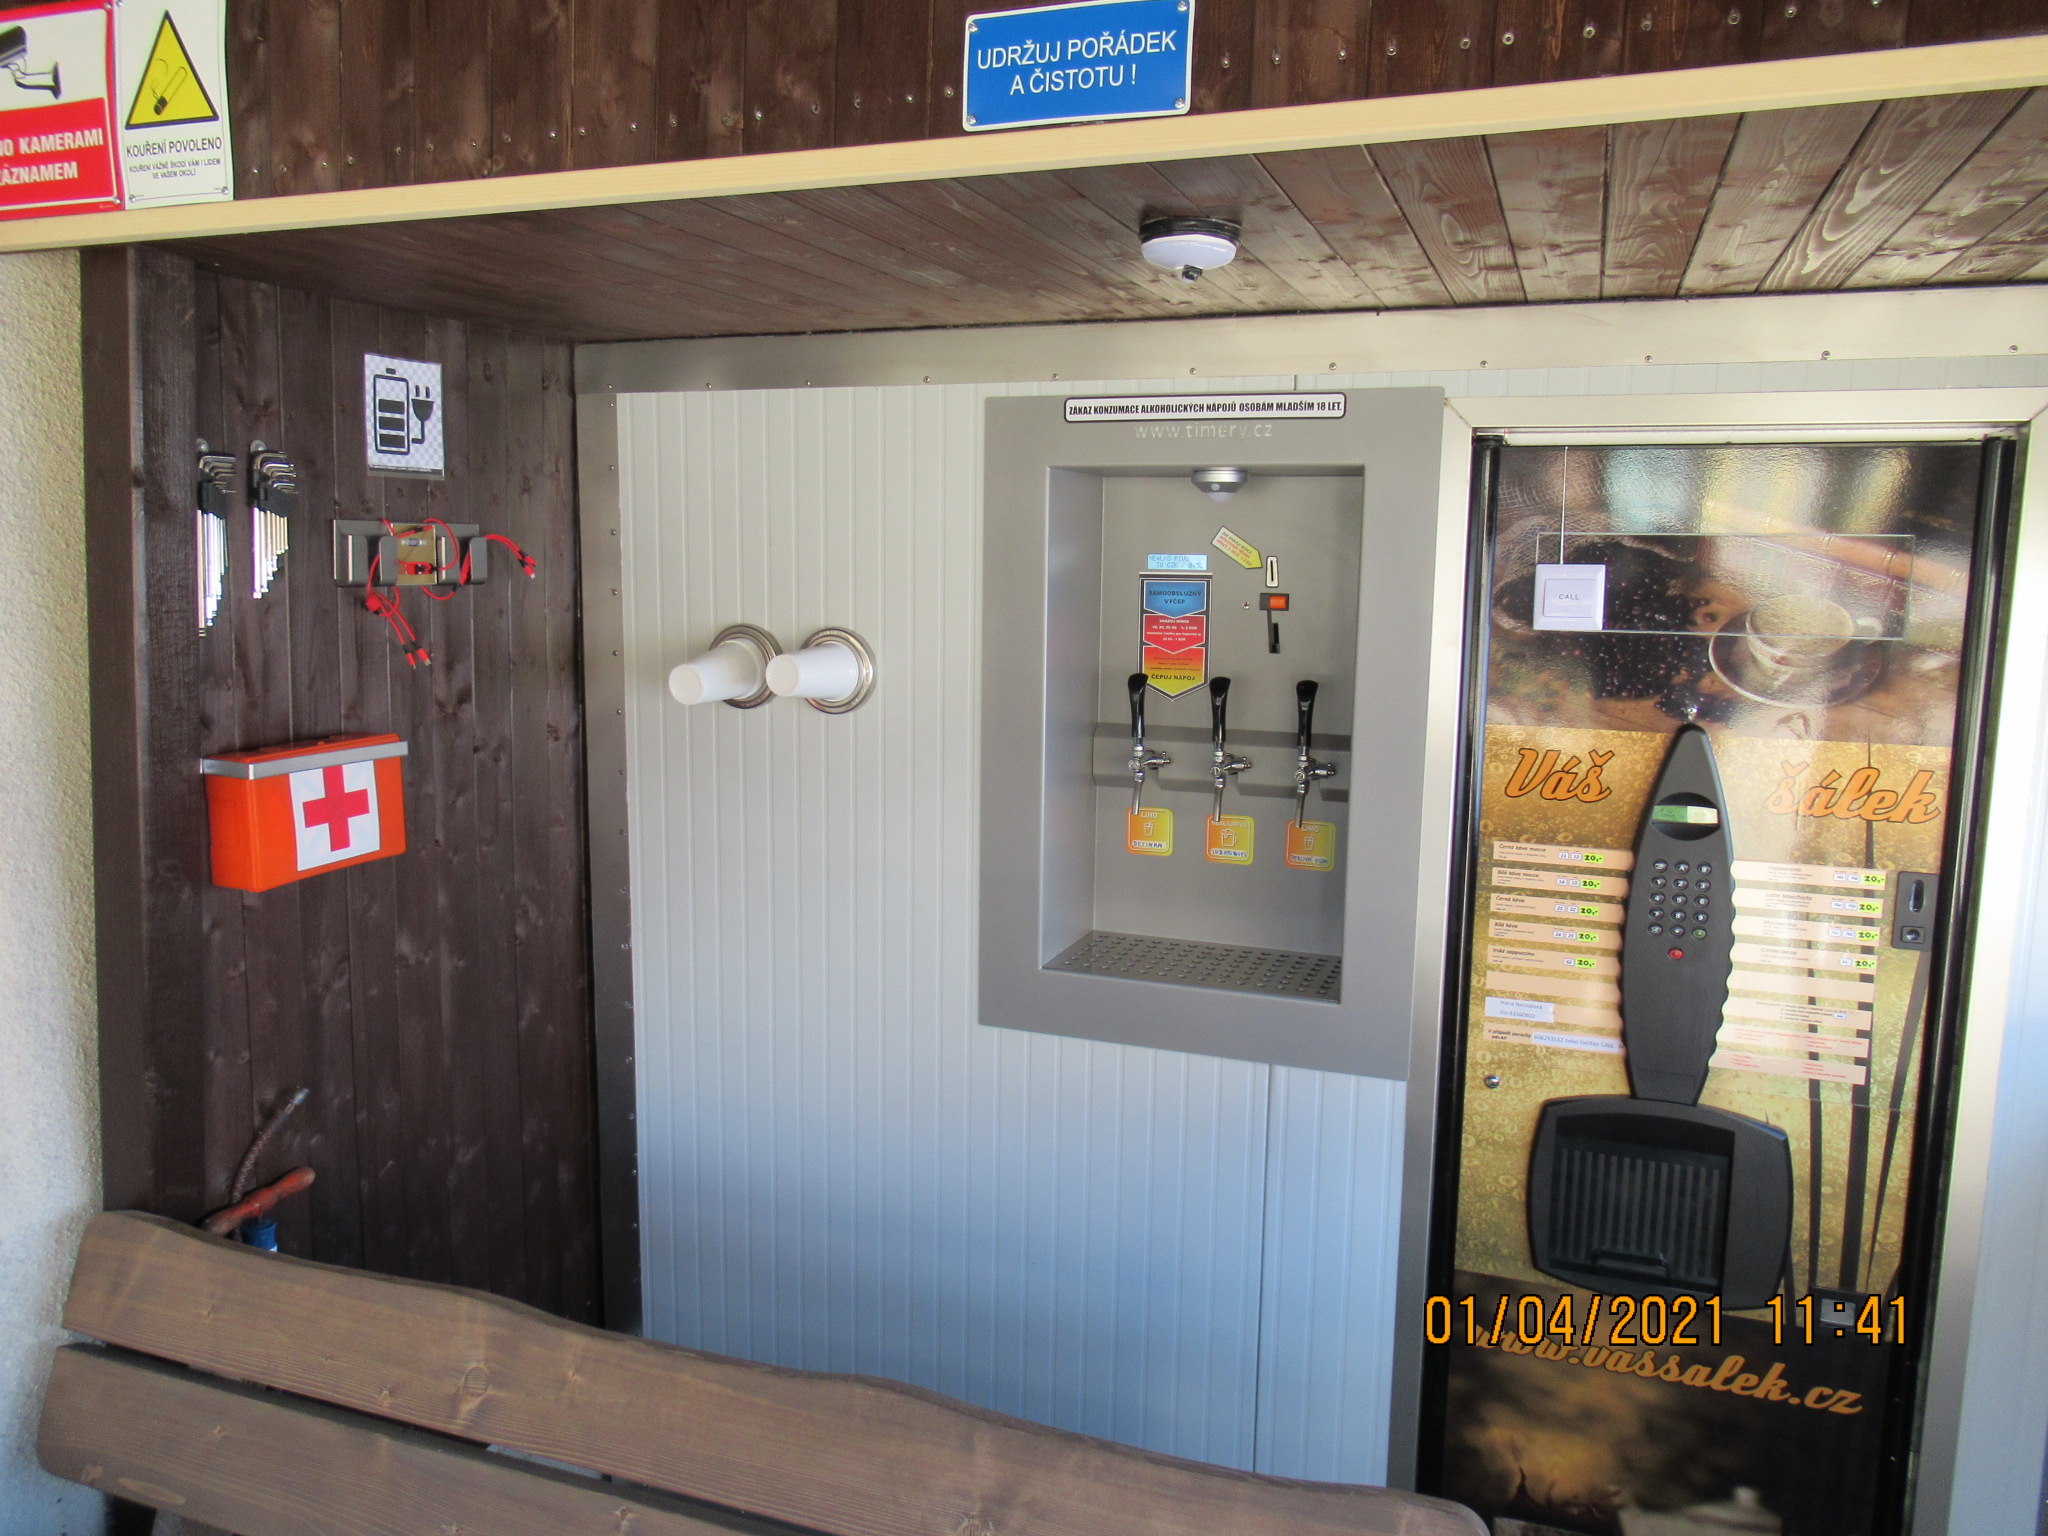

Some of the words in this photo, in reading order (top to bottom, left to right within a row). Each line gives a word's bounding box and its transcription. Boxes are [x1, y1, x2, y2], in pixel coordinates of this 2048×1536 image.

[977, 39, 1061, 70] UDRŽUJ
[1067, 30, 1178, 61] POŘÁDEK
[1010, 75, 1025, 96] A
[1029, 65, 1124, 94] ČISTOTU
[1131, 64, 1137, 86] !
[19, 128, 104, 154] KAMERAMI
[126, 139, 167, 158] KOUŘENÍ
[169, 137, 222, 153] POVOLENO
[1069, 405, 1092, 415] ZÁKAZ
[1093, 405, 1139, 415] KONZUMACE
[1141, 402, 1205, 414] ALKOHOLICKÝCH
[1239, 401, 1274, 412] OSOBÁM
[1276, 400, 1314, 411] MLADŠÍM
[1317, 402, 1326, 411] 18
[1504, 748, 1614, 803] Váš
[1764, 761, 1941, 824] šálek
